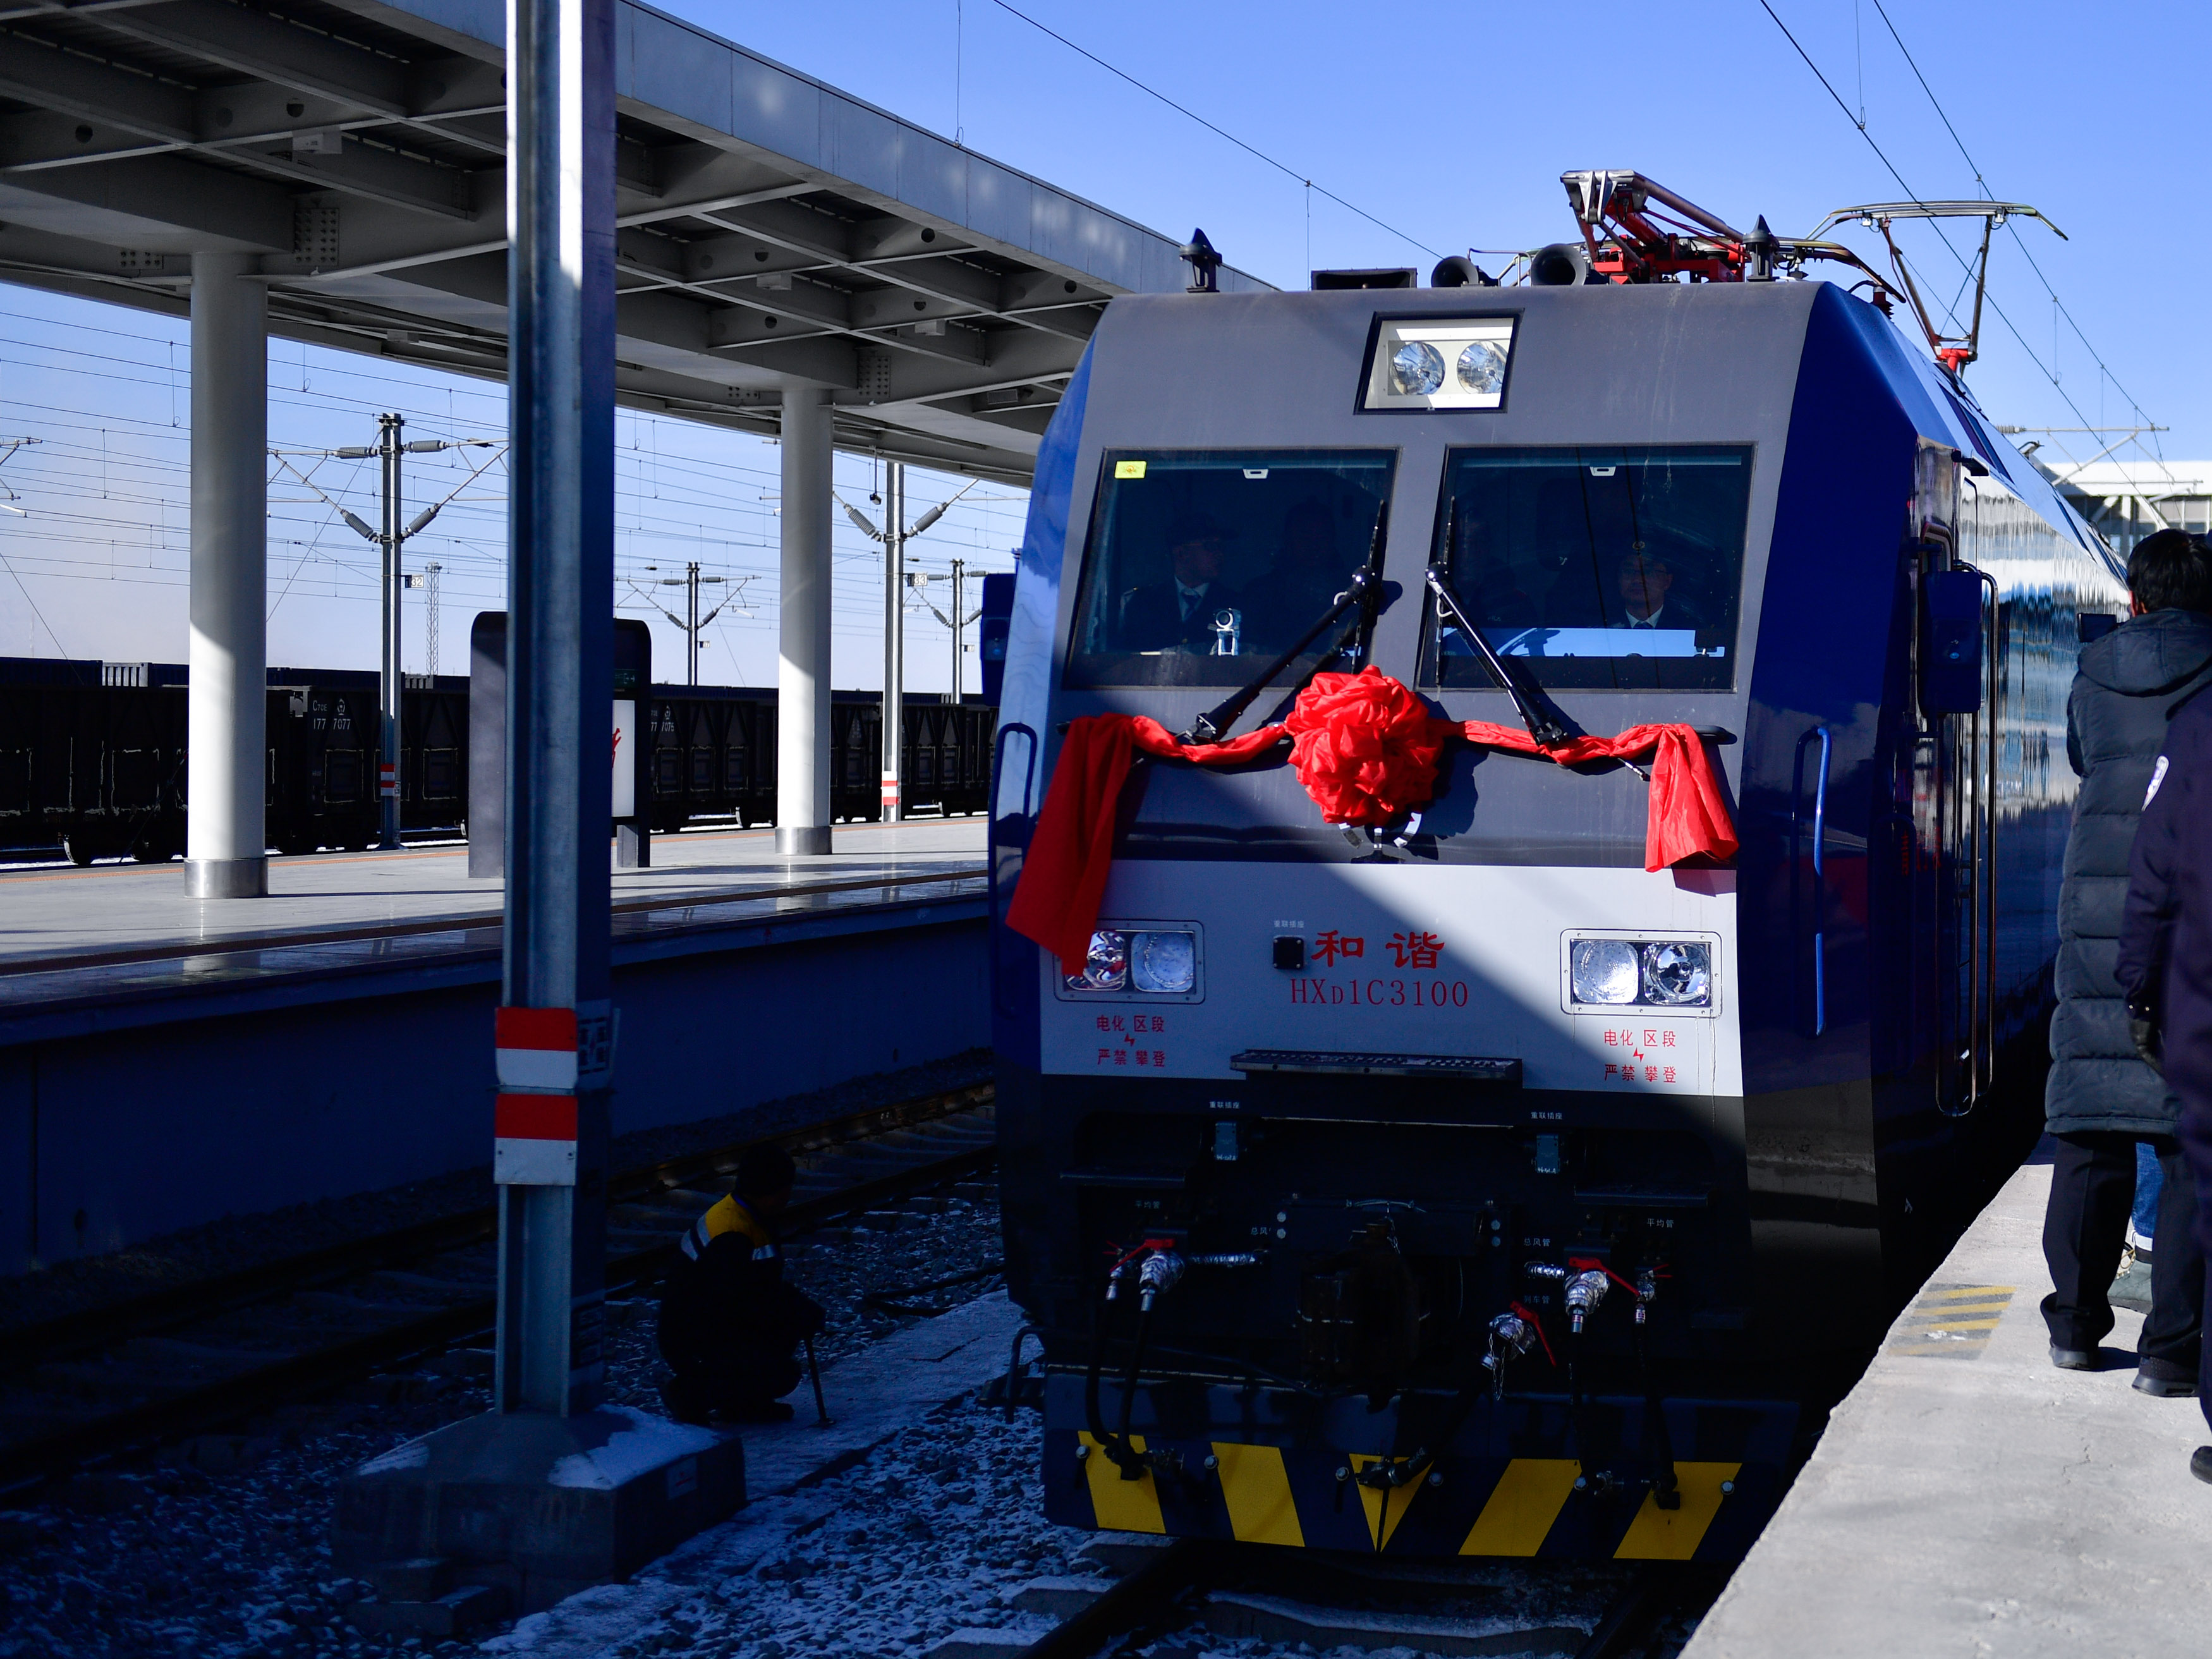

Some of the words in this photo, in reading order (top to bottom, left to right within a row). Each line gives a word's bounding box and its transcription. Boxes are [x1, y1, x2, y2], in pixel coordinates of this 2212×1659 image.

[313, 718, 327, 730] 177
[332, 718, 351, 731] 7077
[1311, 930, 1445, 969] 和谐
[1290, 978, 1469, 1007] HXD1C3100
[1097, 1014, 1165, 1033] 电化区段
[1603, 1028, 1676, 1047] 电化区段
[1097, 1048, 1165, 1067] 严禁攀登
[1604, 1063, 1677, 1083] 严禁攀登
[1530, 1111, 1563, 1120] 重联插座
[1646, 1218, 1674, 1229] 平均管
[1523, 1237, 1551, 1248] 总风管
